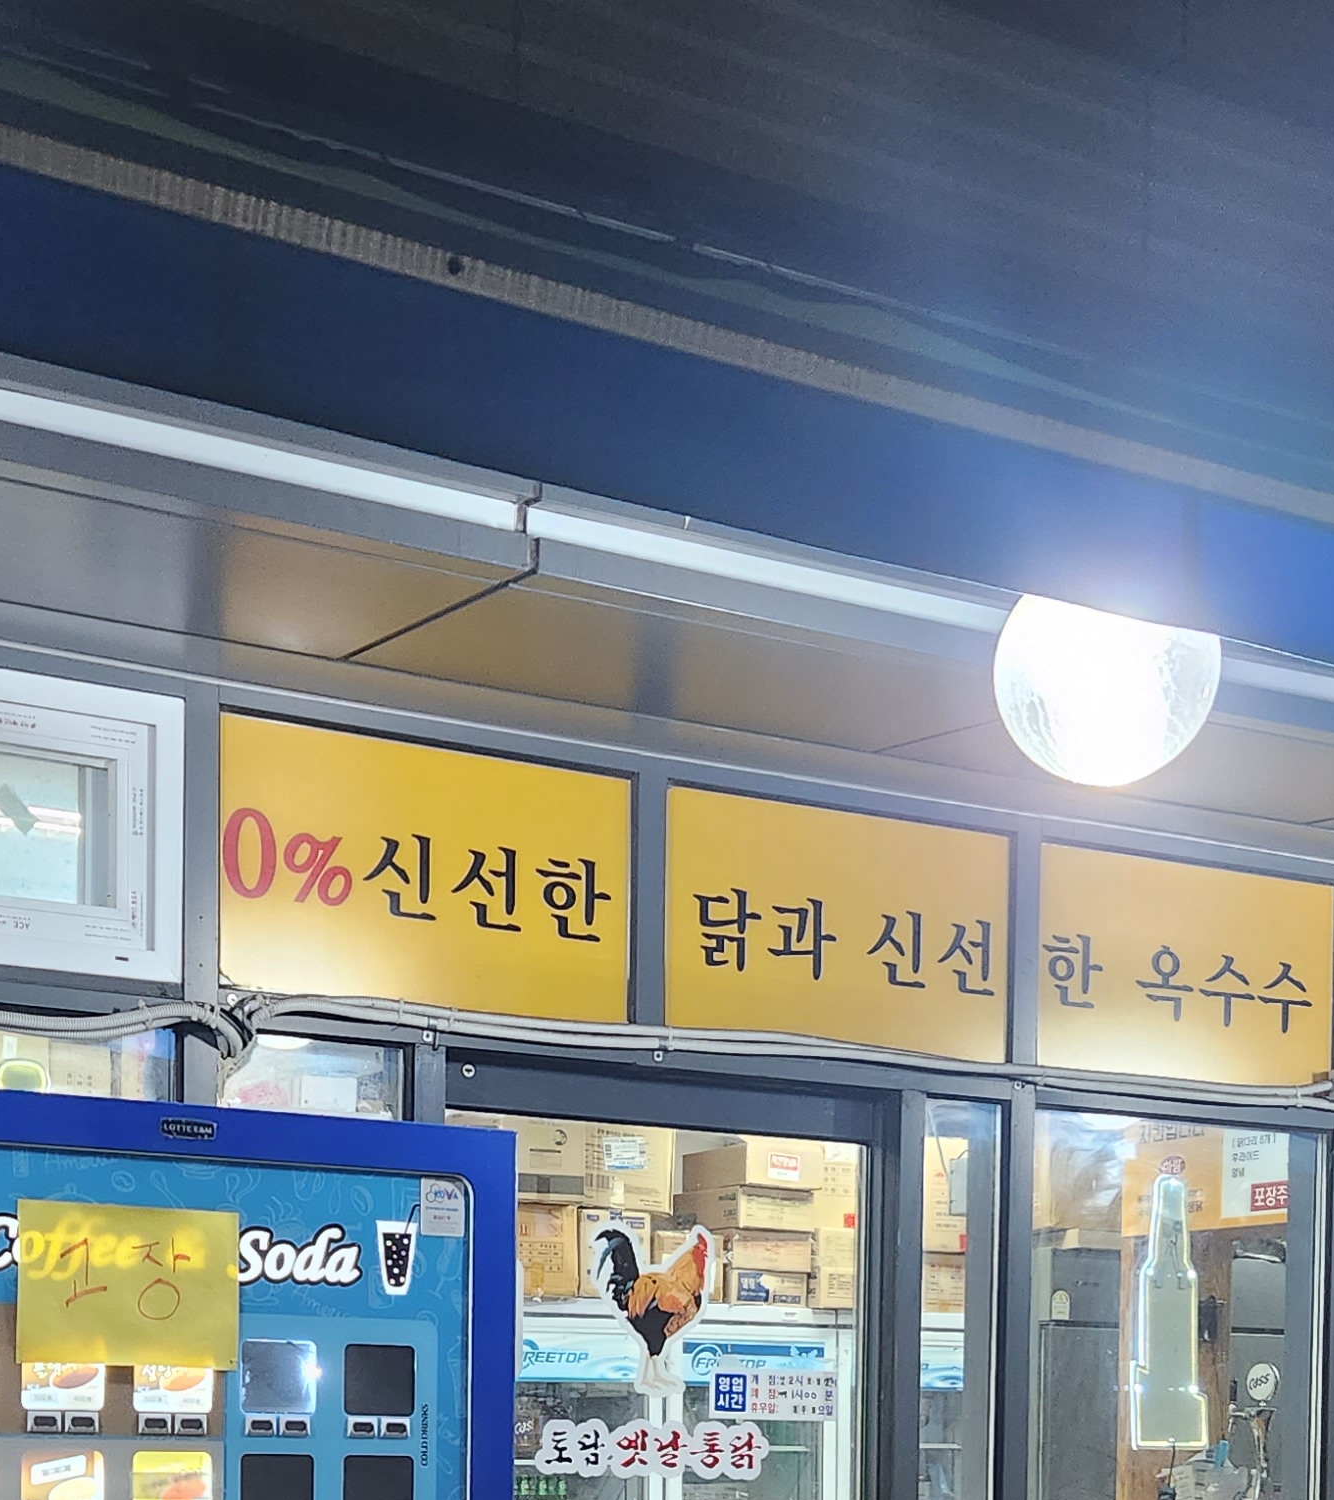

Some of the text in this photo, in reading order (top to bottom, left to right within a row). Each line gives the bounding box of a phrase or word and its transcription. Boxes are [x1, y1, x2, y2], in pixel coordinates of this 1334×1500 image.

[222, 808, 354, 908] 0%
[363, 834, 613, 943] 신선한
[693, 888, 996, 997] 닭과 신선
[1041, 933, 1313, 1036] 한 옥수수
[231, 1225, 362, 1286] Soda
[523, 1350, 589, 1366] REETOP
[718, 1376, 744, 1392] 영업
[716, 1393, 744, 1409] 시간
[420, 1403, 429, 1467] COLD DRINKS
[543, 1428, 763, 1470] 토담 옛날통닭
